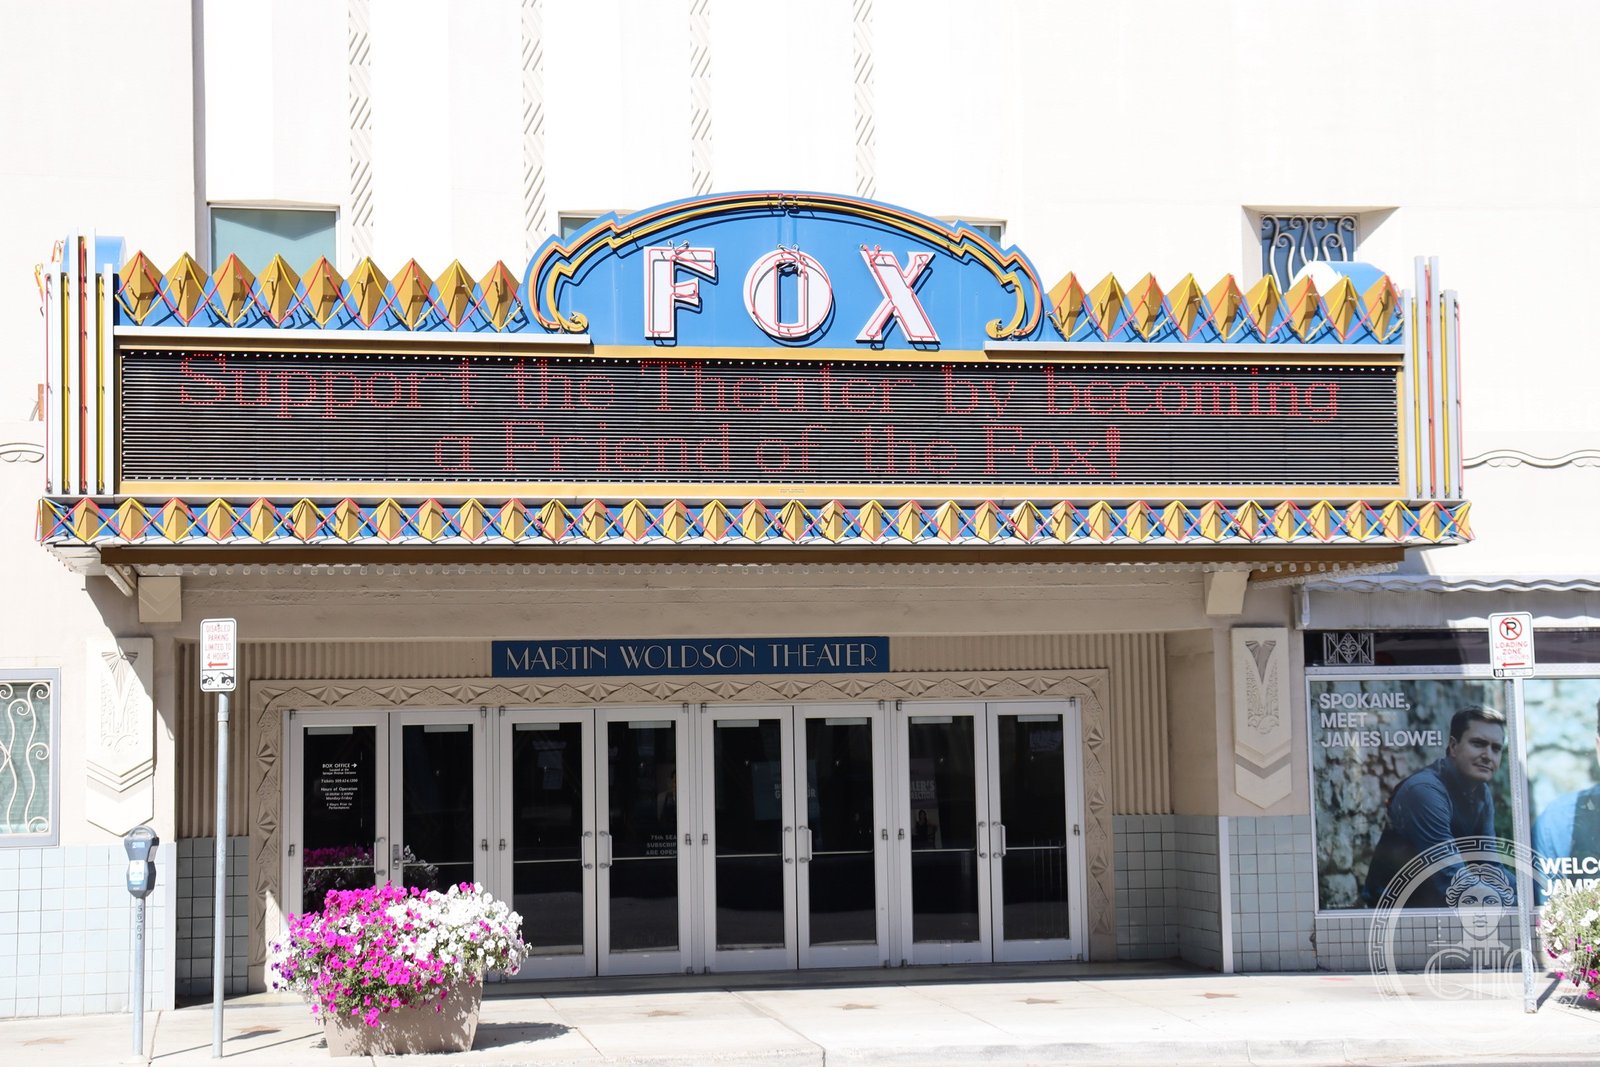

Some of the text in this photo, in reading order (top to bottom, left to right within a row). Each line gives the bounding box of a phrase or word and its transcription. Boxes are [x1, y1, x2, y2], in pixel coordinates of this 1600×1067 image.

[643, 244, 942, 345] FOX
[179, 353, 1341, 424] Support the Theater by becoming
[434, 419, 1121, 479] a Friend of the Fox!
[205, 624, 231, 633] DISABLED
[207, 633, 230, 642] PARKING
[1495, 641, 1528, 649] LOADING
[204, 643, 225, 652] LIMITED
[1502, 648, 1522, 656] ZONE
[212, 652, 230, 661] HOURS
[506, 643, 878, 671] MARTIN WOLDSON THEATER
[1319, 692, 1411, 711] SPOKANE,
[1320, 712, 1368, 728] MEET
[1320, 730, 1442, 748] JAMES LOWE!
[1539, 856, 1600, 875] WELC
